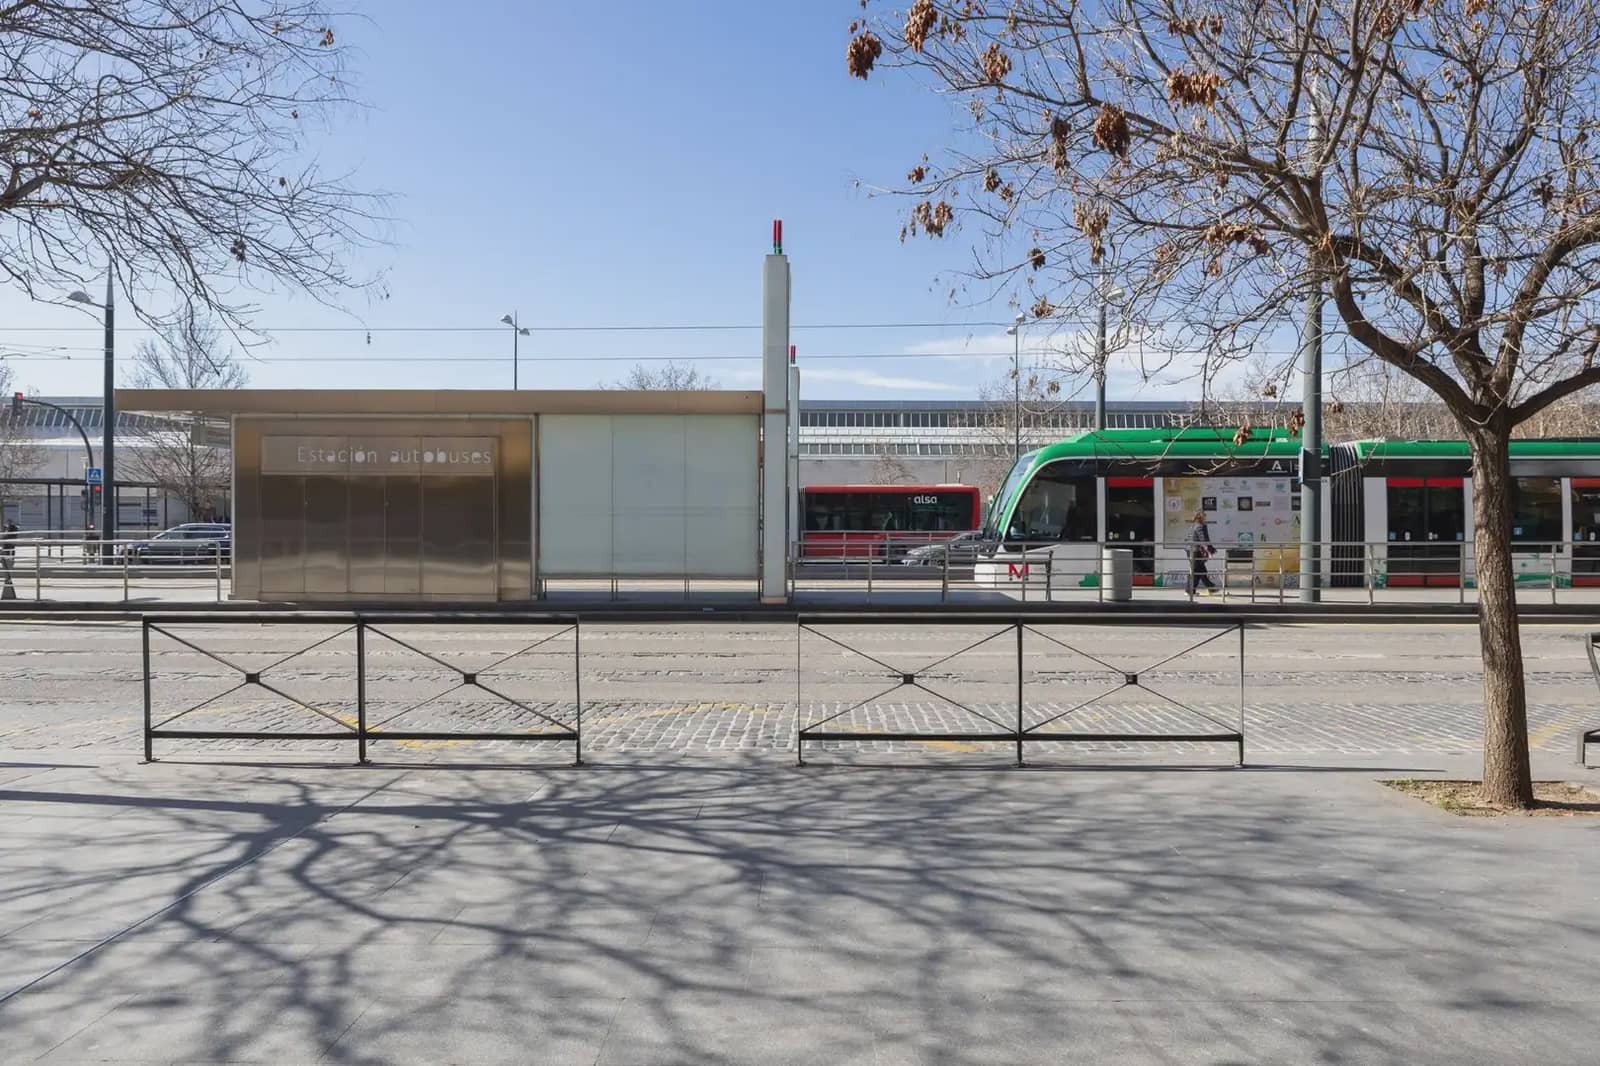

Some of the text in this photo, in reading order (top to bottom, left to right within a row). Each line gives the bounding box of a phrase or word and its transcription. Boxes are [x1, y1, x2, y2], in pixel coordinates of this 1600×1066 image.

[297, 446, 491, 463] Estación autobuses
[913, 494, 937, 504] alsa
[1008, 562, 1029, 579] M
